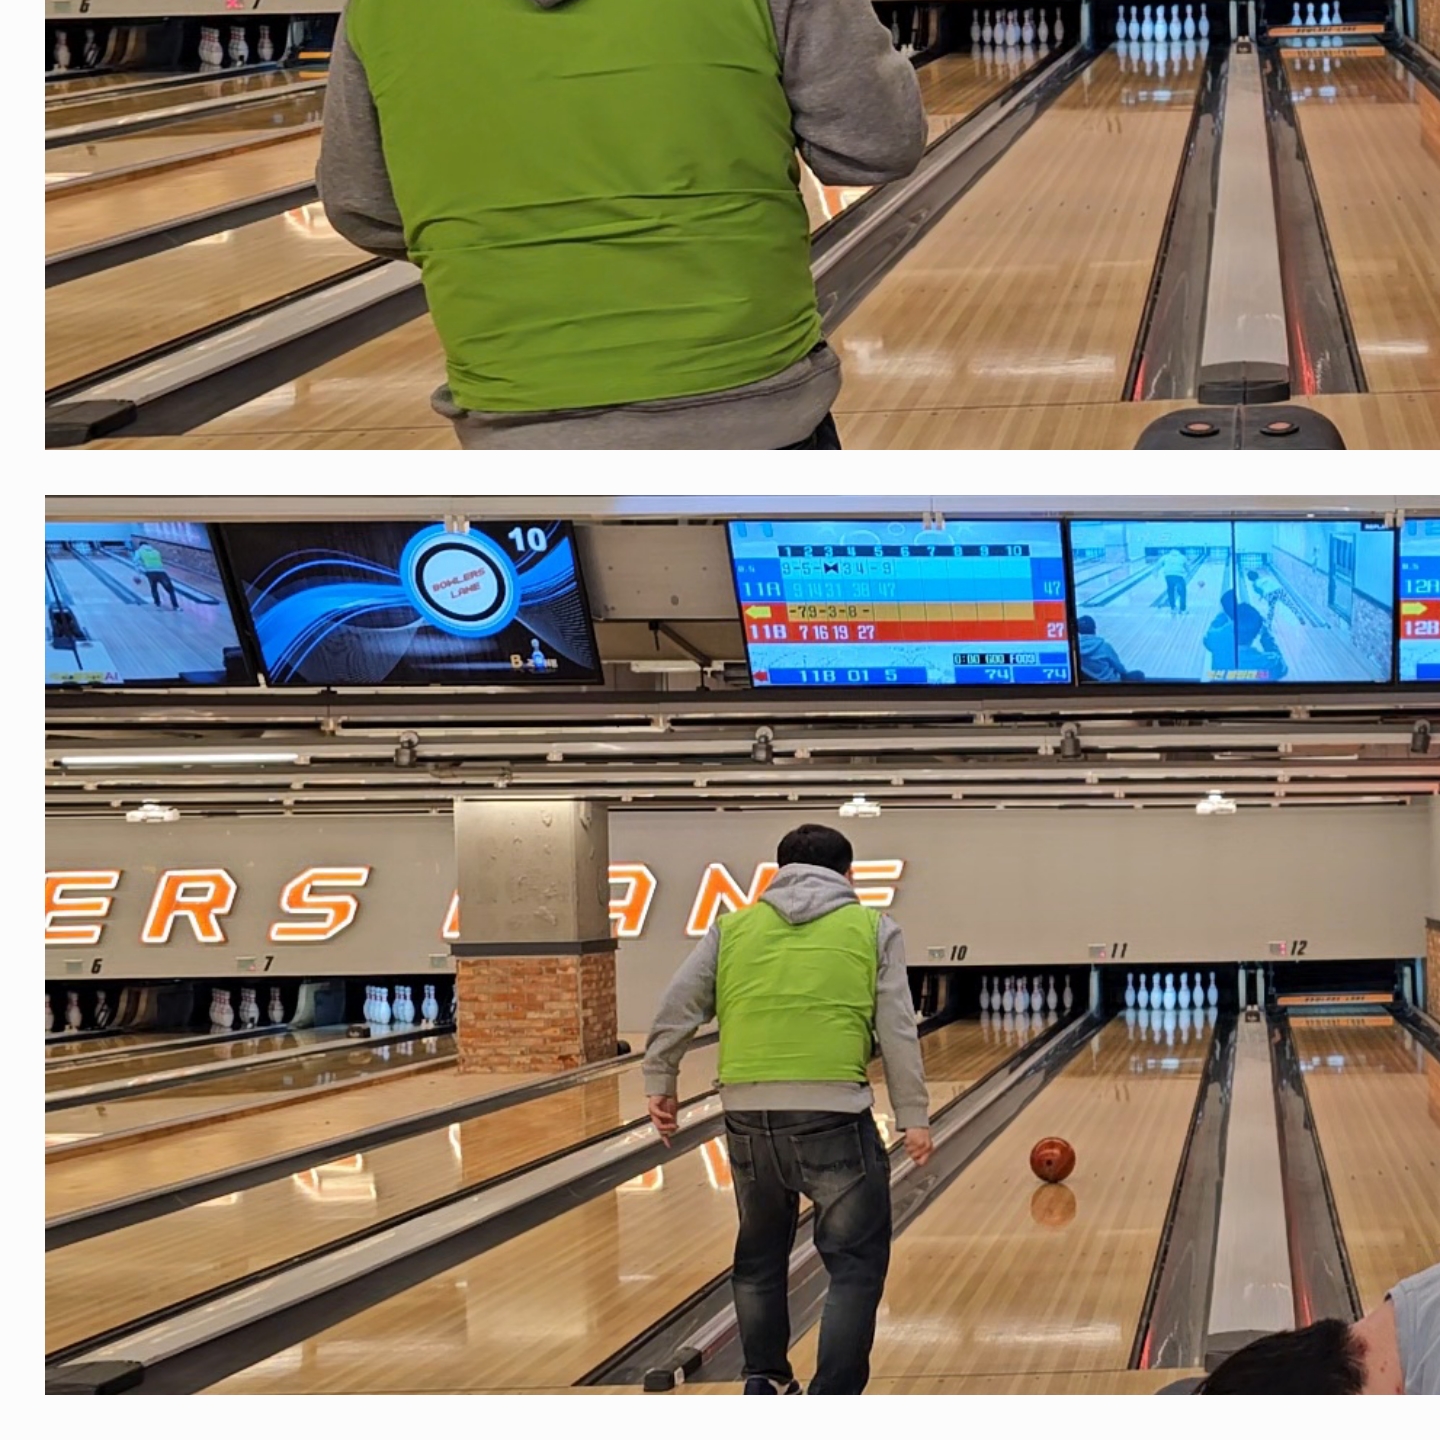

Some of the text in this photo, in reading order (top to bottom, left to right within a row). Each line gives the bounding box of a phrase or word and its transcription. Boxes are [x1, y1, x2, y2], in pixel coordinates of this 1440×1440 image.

[508, 526, 547, 553] 10
[433, 567, 486, 595] BOWLERS
[744, 583, 781, 596] 11A
[451, 582, 482, 600] LANE
[813, 626, 828, 639] 16
[833, 626, 848, 639] 19
[858, 625, 874, 639] 27
[1047, 623, 1064, 637] 27
[848, 669, 869, 681] 01
[885, 669, 897, 681] 5
[985, 669, 1009, 679] 74
[1043, 669, 1067, 679] 74
[950, 941, 1308, 960] 10 11 12
[91, 957, 274, 975] 6 7
